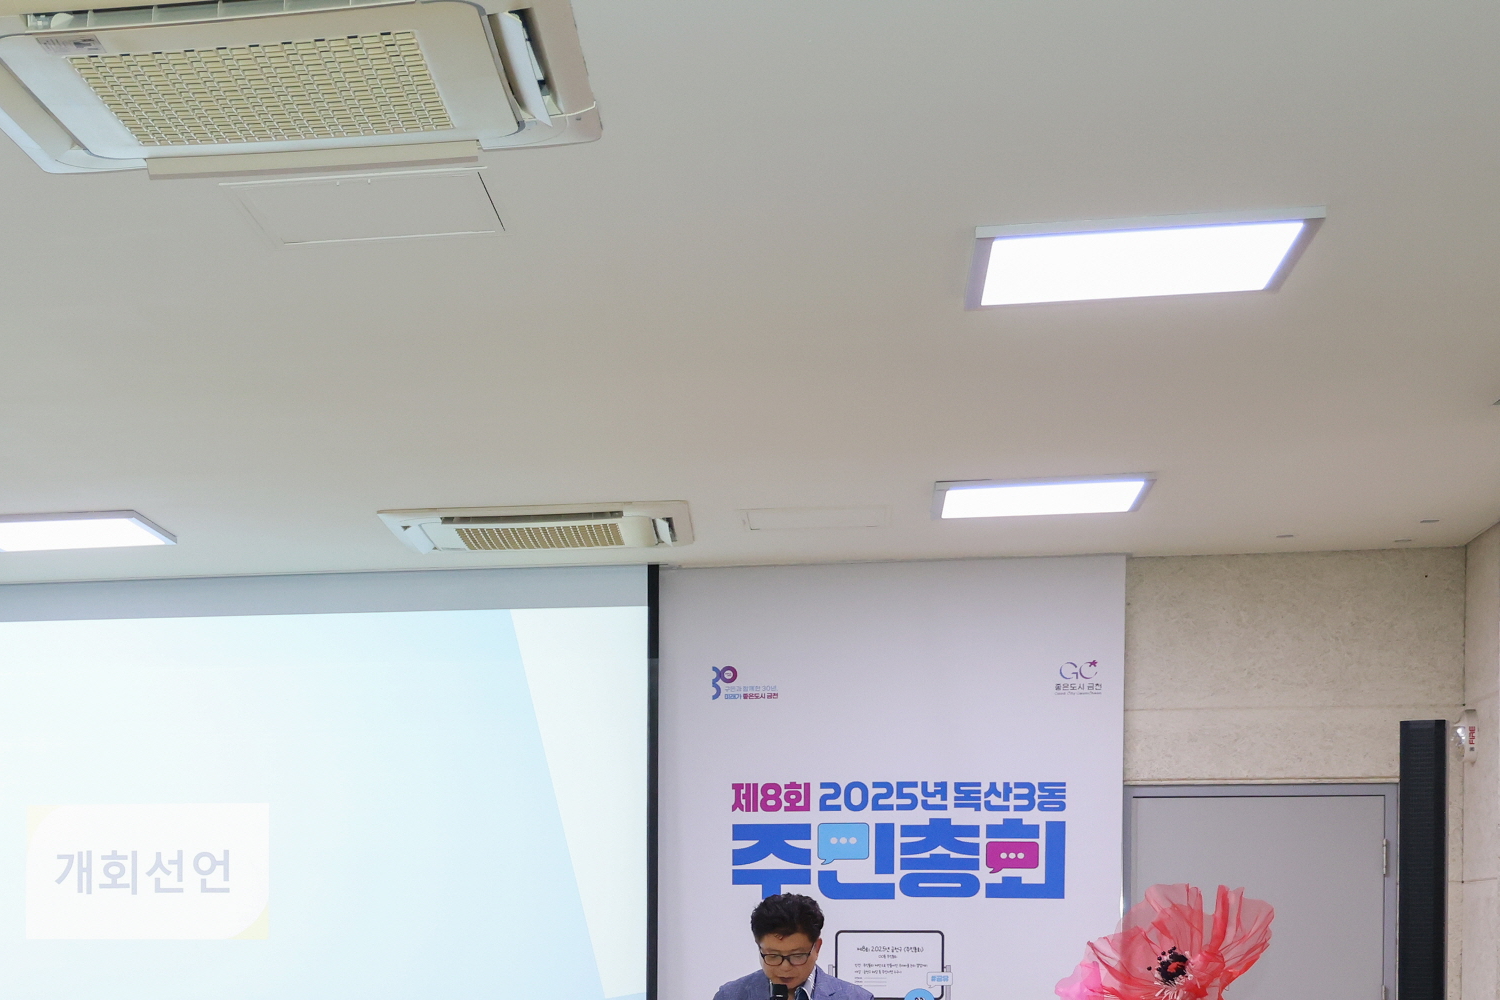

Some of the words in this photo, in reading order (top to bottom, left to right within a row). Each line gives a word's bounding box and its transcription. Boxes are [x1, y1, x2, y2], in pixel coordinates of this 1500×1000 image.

[1087, 683, 1102, 691] 금천
[1468, 725, 1476, 745] FIRE
[731, 781, 811, 813] 제8회
[818, 780, 948, 812] 2025년
[953, 780, 1067, 812] 독산3동
[54, 849, 232, 896] 개회선언
[731, 818, 1067, 901] 주민총회
